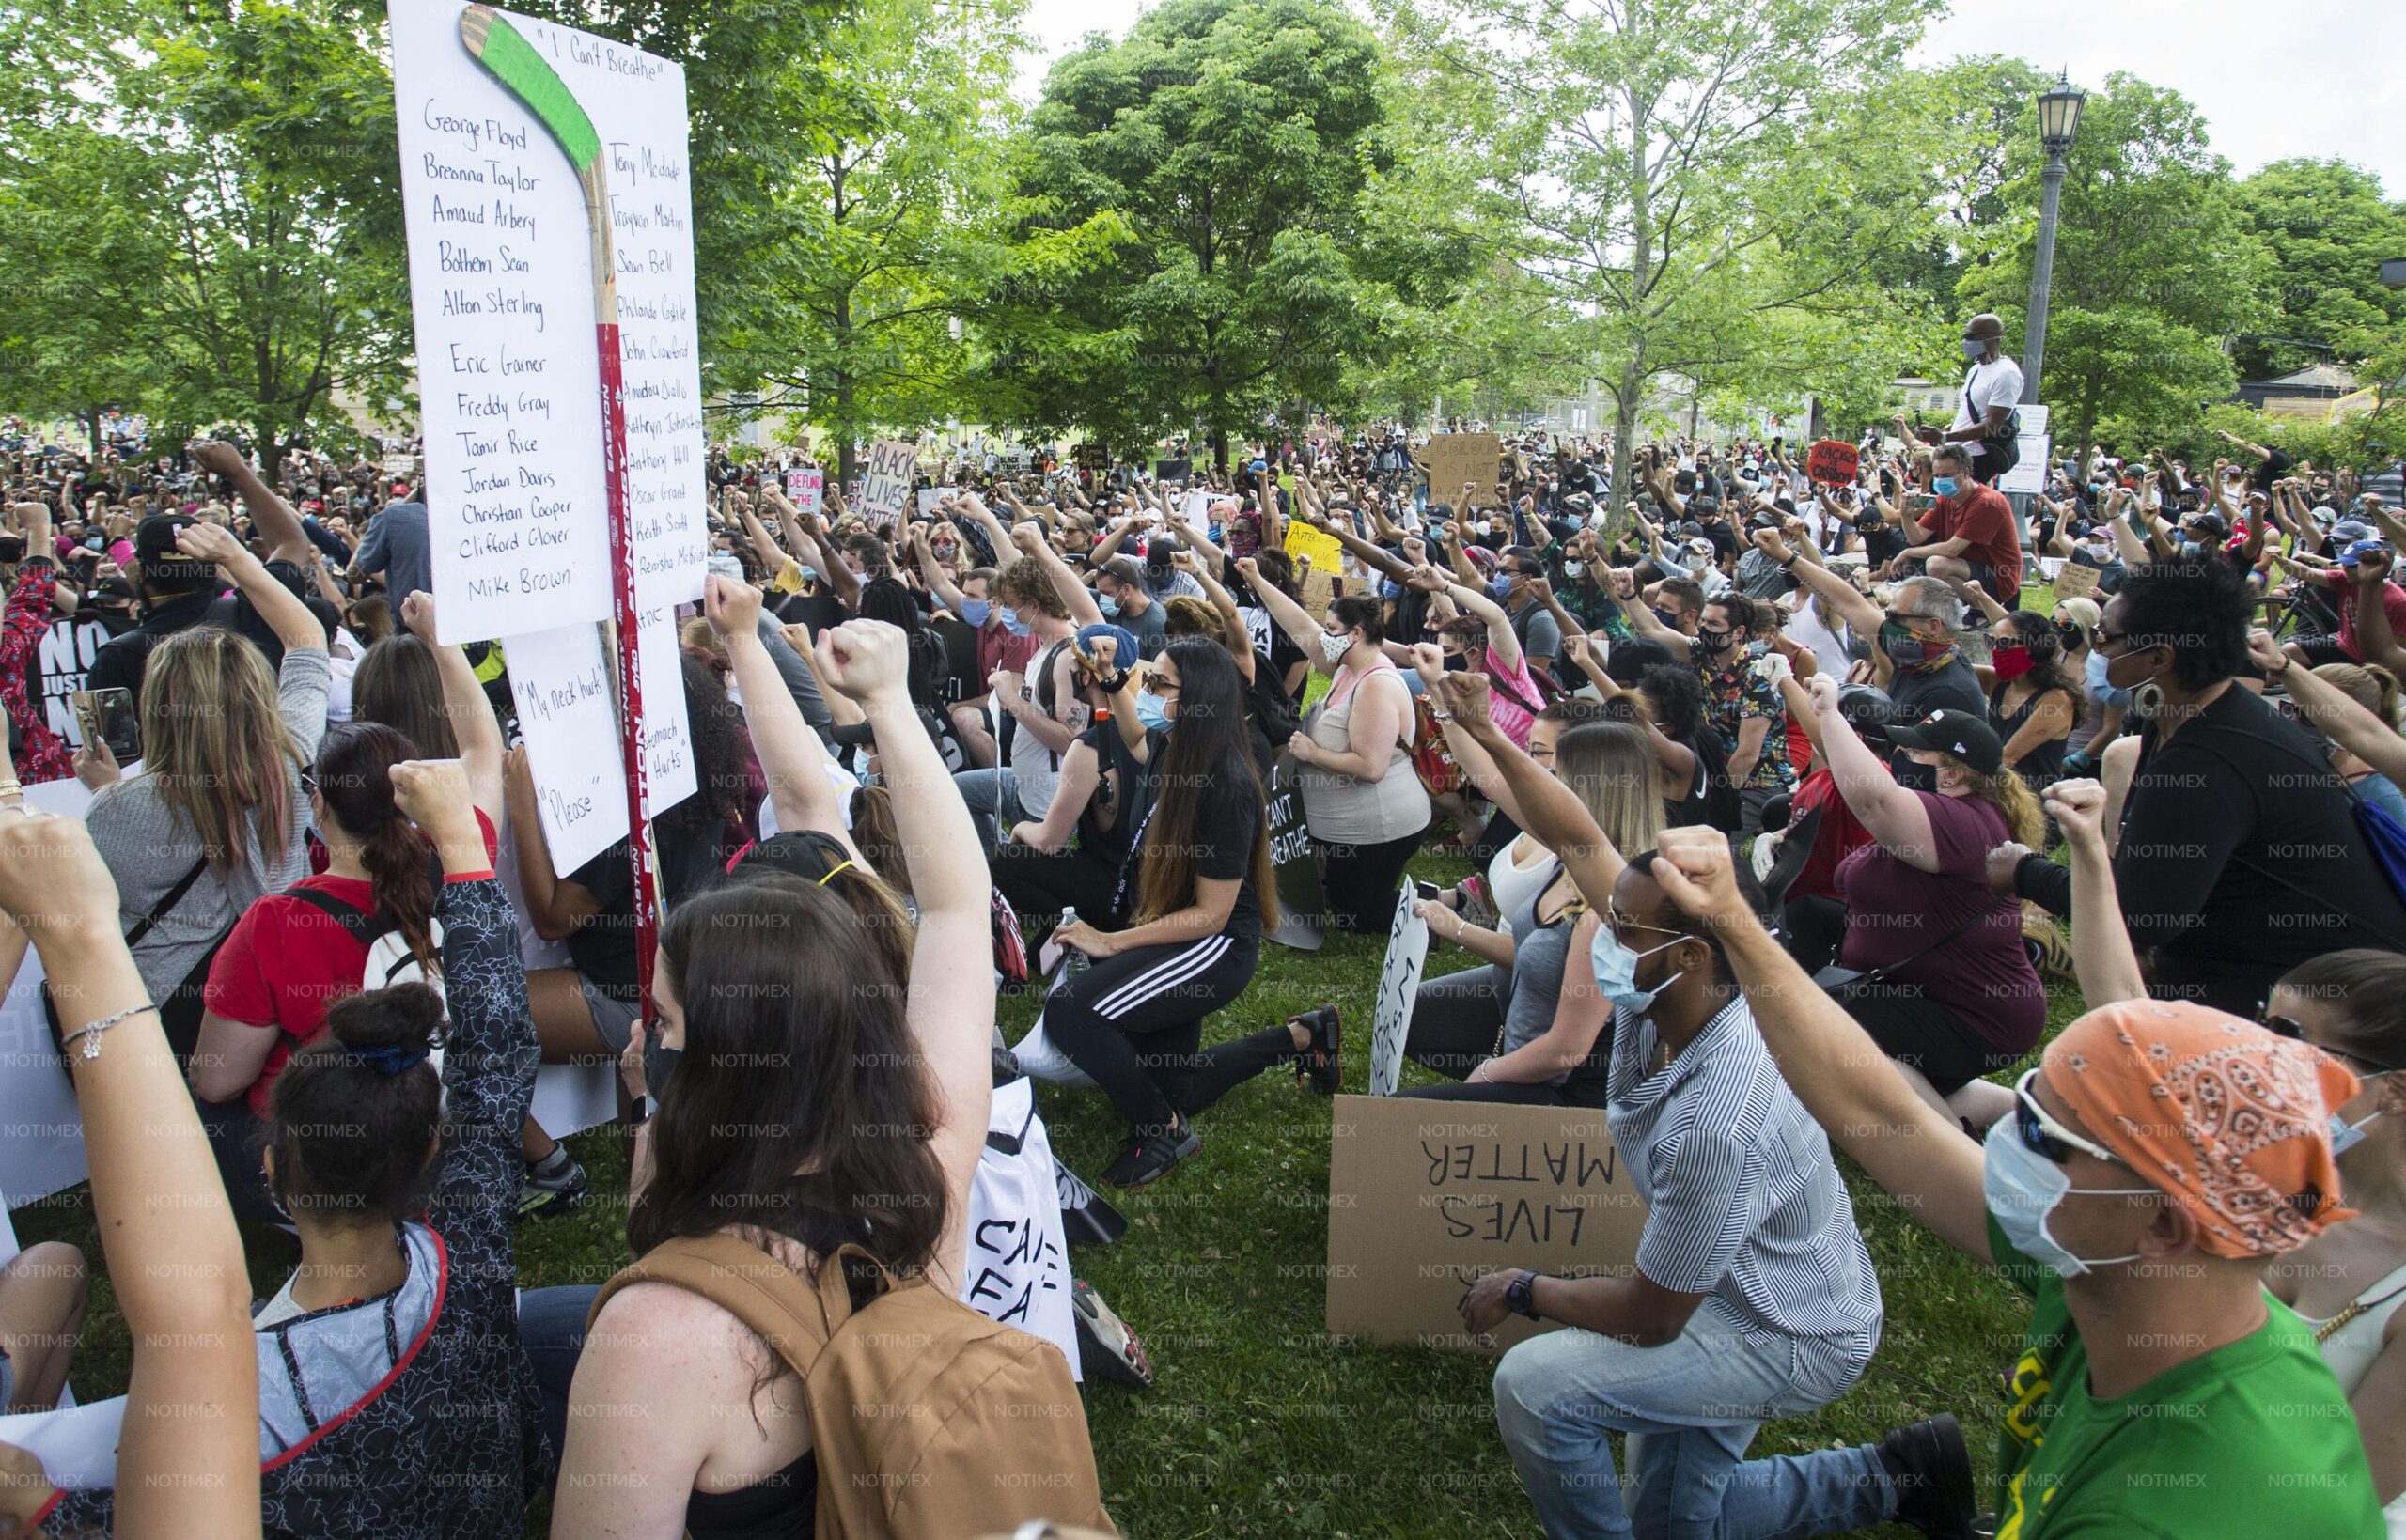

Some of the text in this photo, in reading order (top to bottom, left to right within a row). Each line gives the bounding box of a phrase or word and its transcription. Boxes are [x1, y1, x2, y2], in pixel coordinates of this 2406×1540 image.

[570, 35, 602, 67] Can't
[424, 98, 526, 152] George Floyd
[423, 152, 541, 194] Breonna Taylor
[609, 142, 635, 187] Tony
[495, 199, 536, 241] Arbery
[608, 194, 684, 238] Trayvon Martin
[617, 248, 672, 274] Sean Bell
[442, 288, 544, 333] Alton Sterling
[450, 342, 547, 376] Eric Garner
[618, 333, 689, 362] John Crawford
[457, 391, 550, 422] Freddy Gray
[455, 429, 539, 457] Tamir Rice
[602, 383, 615, 473] EASTON
[624, 413, 663, 441] Kathryn
[629, 444, 689, 474] Anthony Hill
[871, 443, 916, 481] BLACK
[1436, 437, 1499, 457] COLOUR
[461, 466, 555, 494] Jordan Davis
[789, 474, 823, 490] DEFUND
[1445, 460, 1495, 477] IS NOT
[630, 480, 686, 504] Oscar Grant
[795, 493, 813, 506] THE
[865, 475, 909, 511] LIVES
[1448, 485, 1490, 500] CRE
[462, 496, 572, 525] Christian Cooper
[636, 520, 662, 541] Keith
[665, 512, 688, 532] Scott
[459, 526, 570, 558] Clifford Glover
[617, 441, 635, 615] SYNERGY
[639, 551, 674, 576] Renisha
[469, 568, 570, 601] Mike Brown
[1303, 574, 1365, 597] SILECE
[39, 620, 112, 677] NO
[41, 672, 89, 697] JUST
[551, 681, 577, 711] neck
[618, 638, 631, 739] SYNERGY
[1272, 765, 1279, 791] I
[635, 715, 652, 875] EASTON
[1265, 793, 1293, 831] CAN'T
[632, 847, 644, 928] EASTON
[1384, 957, 1415, 1097] CISM
[1420, 1140, 1616, 1188] MATTER
[1440, 1195, 1585, 1247] LIVES
